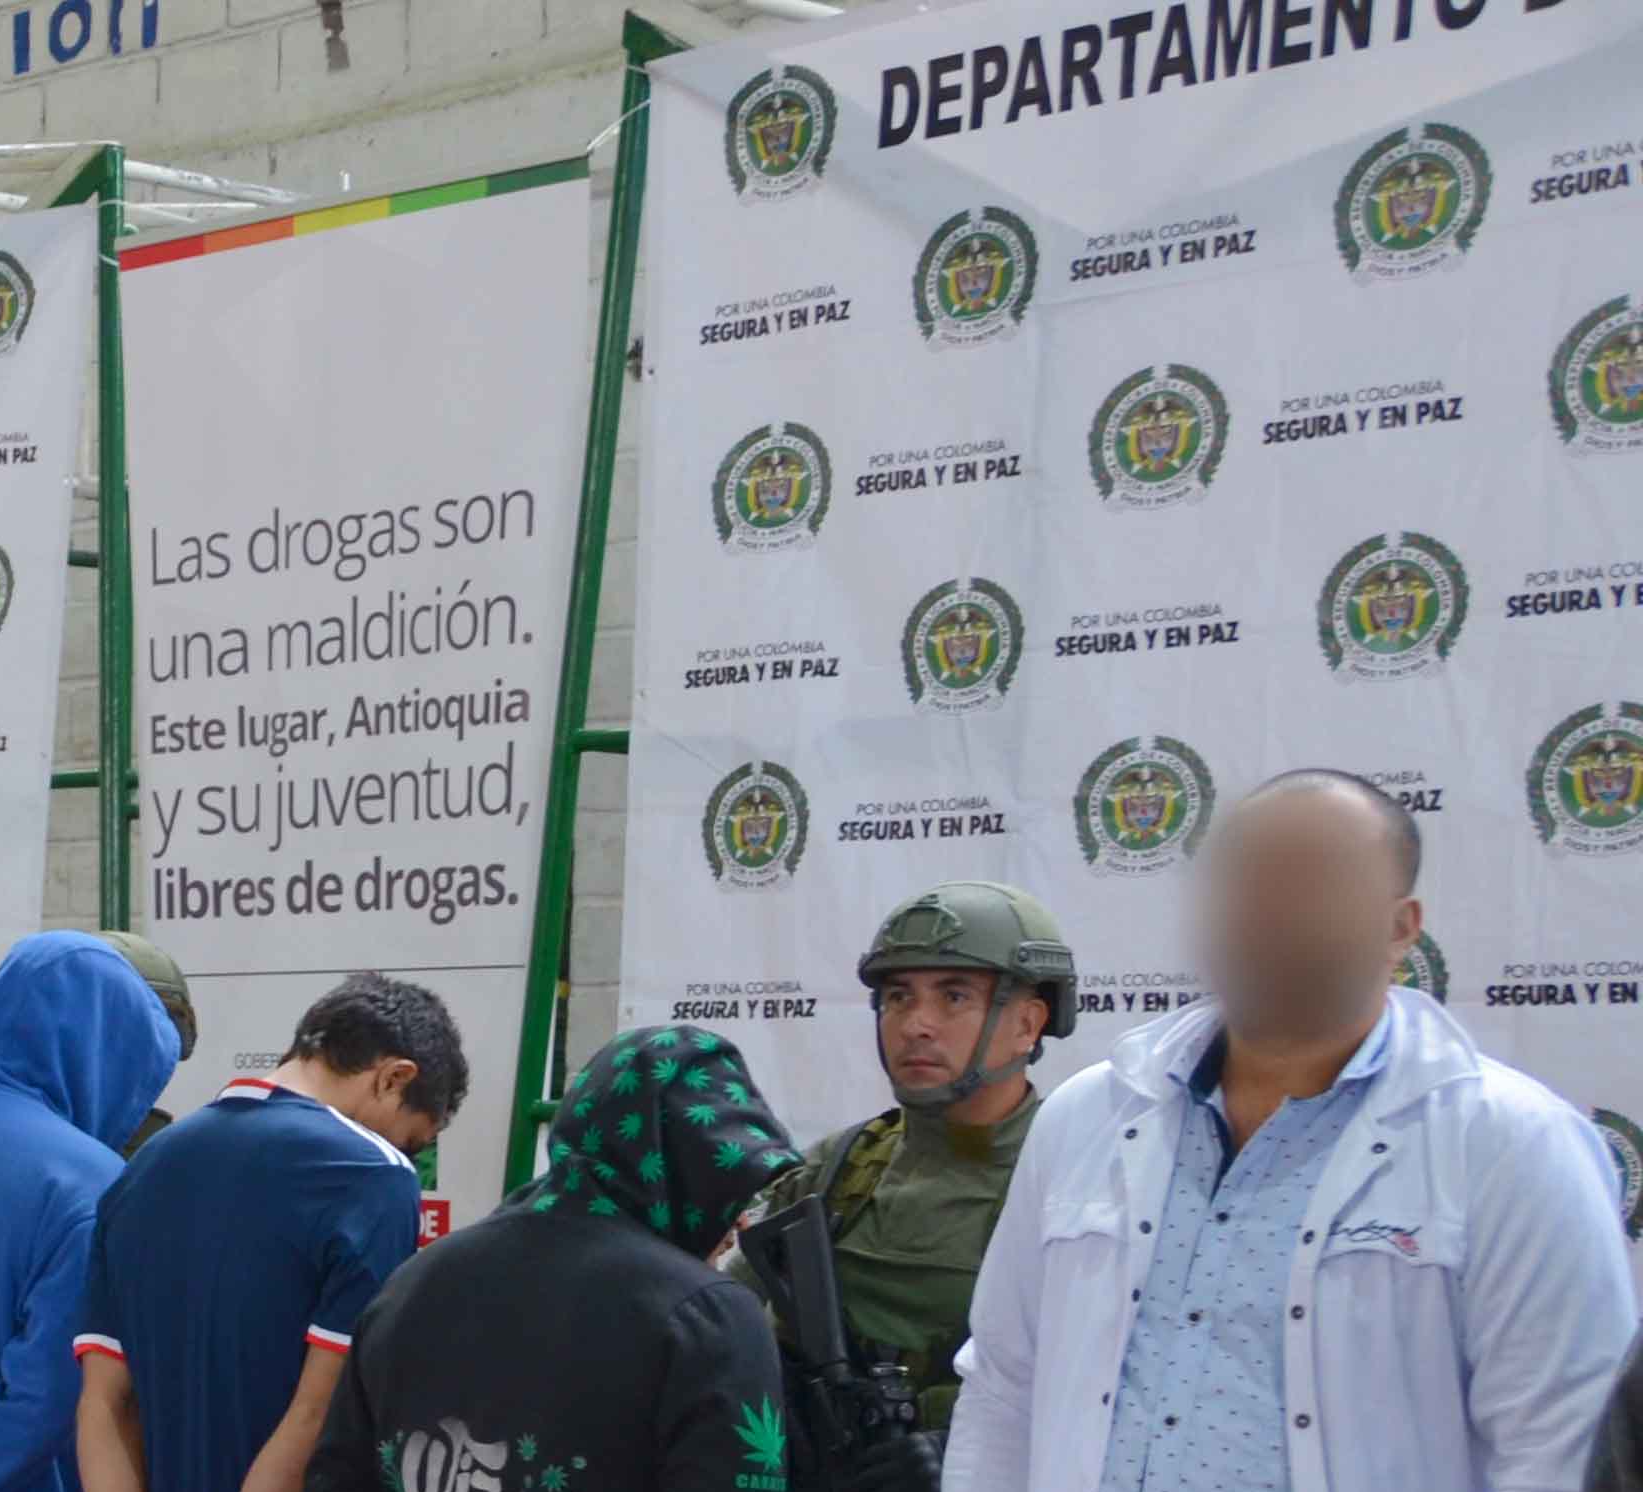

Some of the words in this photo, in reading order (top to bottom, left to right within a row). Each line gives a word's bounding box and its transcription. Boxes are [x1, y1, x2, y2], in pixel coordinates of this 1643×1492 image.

[1530, 163, 1630, 205] SEGURA
[1085, 231, 1116, 251] POR
[1119, 226, 1154, 246] UNA
[1158, 212, 1239, 239] COLOMBIA
[1070, 246, 1151, 282] SEGURA
[1158, 243, 1173, 267] Y
[1178, 238, 1206, 264] EN
[1214, 229, 1257, 258] PAZ
[715, 300, 740, 318] POR
[742, 295, 771, 313] UNA
[774, 284, 836, 308] COLOMBIA
[700, 314, 769, 345] SEGURA
[774, 312, 784, 333] Y
[788, 307, 809, 330] EN
[814, 300, 851, 326] PAZ
[1281, 397, 1310, 415] POR
[1313, 391, 1350, 410] UNA
[1354, 379, 1444, 405] COLOMBIA
[1262, 411, 1347, 445] SEGURA
[1355, 408, 1371, 433] Y
[1377, 404, 1408, 431] EN
[1413, 397, 1464, 426] PAZ
[12, 446, 38, 466] PAZ
[869, 451, 896, 469] POR
[899, 448, 930, 465] UNA
[934, 439, 1006, 460] COLOMBIA
[855, 468, 927, 496] SEGURA
[933, 465, 946, 487] Y
[952, 461, 978, 485] EN
[983, 455, 1021, 481] PAZ
[150, 523, 231, 586] Las
[247, 500, 421, 582] drogas
[434, 487, 535, 550] son
[1524, 569, 1556, 587] POR
[1565, 564, 1604, 583] UNA
[1070, 613, 1099, 629] POR
[1103, 610, 1140, 627] UNA
[1142, 603, 1222, 623] COLOMBIA
[1505, 586, 1602, 619] SEGURA
[1610, 584, 1627, 608] Y
[149, 624, 250, 683] una
[266, 579, 535, 673] maldición.
[1054, 630, 1137, 658] SEGURA
[1143, 628, 1156, 650] Y
[1164, 625, 1192, 649] EN
[1196, 621, 1239, 646] PAZ
[696, 649, 722, 664] POR
[726, 646, 752, 661] UNA
[754, 641, 826, 659] COLOMBIA
[683, 664, 750, 690] SEGURA
[754, 663, 766, 684] Y
[771, 661, 794, 683] EN
[799, 657, 839, 681] PAZ
[150, 711, 226, 756] Este
[237, 698, 335, 759] lugar,
[345, 681, 531, 741] Antioquia
[152, 786, 184, 859] y
[197, 783, 262, 836] su
[270, 741, 531, 852] juventud,
[855, 801, 883, 816] POR
[886, 799, 917, 814] UNA
[920, 795, 991, 812] COLOMBIA
[837, 818, 914, 842] SEGURA
[920, 817, 932, 838] Y
[939, 815, 963, 837] EN
[969, 813, 1005, 836] PAZ
[154, 866, 275, 922] libres
[286, 860, 342, 914] de
[355, 856, 519, 925] drogas.
[1502, 963, 1535, 980] POR
[1540, 962, 1577, 979] UNA
[671, 1000, 739, 1020] SEGURA
[746, 999, 757, 1019] Y
[782, 998, 818, 1018] PAZ
[1142, 991, 1169, 1013] EN
[1485, 982, 1578, 1007] SEGURA
[1584, 982, 1601, 1005] Y
[1608, 981, 1639, 1004] EN
